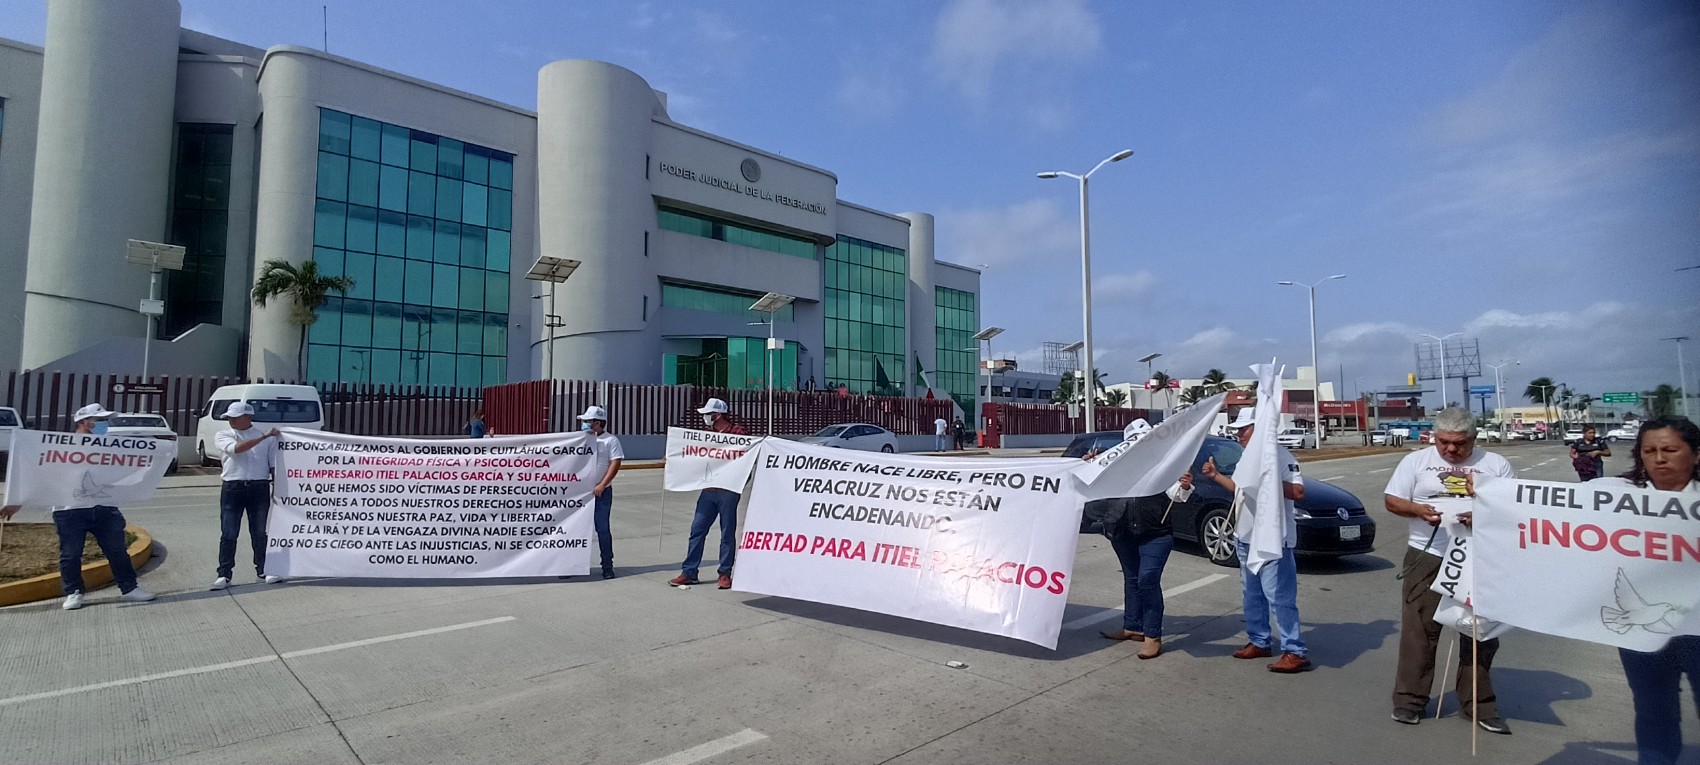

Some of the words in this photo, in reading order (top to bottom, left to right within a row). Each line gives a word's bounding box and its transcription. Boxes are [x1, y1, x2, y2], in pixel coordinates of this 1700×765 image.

[660, 162, 696, 182] PODER
[699, 172, 743, 194] JUDICIAL
[745, 185, 759, 198] DE
[761, 189, 773, 201] LA
[776, 194, 827, 215] FEDERACIÓN
[42, 433, 76, 445] ITIEL
[81, 436, 157, 450] PALACIOS
[683, 431, 703, 442] ITIEL
[705, 433, 752, 446] PALACIOS
[278, 441, 394, 454] RESPONSABILIZAMOS
[397, 445, 411, 454] AL
[414, 446, 472, 455] GOBIERNO
[474, 446, 487, 455] DE
[490, 444, 550, 455] CUITLÁHUC
[553, 444, 594, 456] GARCÍA
[39, 450, 154, 467] ¡INOCENTE!
[318, 455, 339, 465] POR
[342, 456, 356, 465] LA
[358, 456, 424, 466] INTEGRIDAD
[426, 457, 461, 467] FÍSICA
[464, 459, 472, 467] Y
[474, 456, 550, 468] PSICOLÓGICA
[287, 469, 304, 478] DEL
[307, 469, 374, 479] EMPRESARIO
[376, 470, 400, 480] ITIEL
[403, 471, 458, 480] PALACIOS
[461, 469, 504, 481] GARCÍA
[507, 472, 514, 481] Y
[517, 473, 531, 482] SU
[535, 473, 581, 482] FAMILIA.
[765, 454, 780, 469] EL
[783, 455, 852, 472] HOMBRE
[853, 462, 905, 477] NACE
[905, 468, 962, 485] LIBRE,
[968, 472, 1026, 490] PERO
[1030, 475, 1061, 494] EN
[298, 483, 312, 492] YA
[314, 483, 335, 494] QUE
[338, 484, 376, 493] HEMOS
[379, 484, 405, 493] SIDO
[408, 482, 460, 495] VÍCTIMAS
[463, 486, 477, 495] DE
[480, 484, 557, 495] PERSECUCIÓN
[560, 486, 568, 495] Y
[794, 477, 884, 499] VERACRUZ
[886, 484, 928, 503] NOS
[932, 489, 1001, 512] ESTÁN
[280, 497, 348, 507] VIOLACIONES
[350, 498, 358, 507] A
[361, 498, 398, 507] TODOS
[401, 498, 460, 508] NUESTROS
[462, 499, 522, 509] DERECHOS
[525, 499, 586, 509] HUMANOS.
[1516, 484, 1583, 510] ITIEL
[306, 509, 374, 521] REGRÉSANOS
[377, 512, 426, 522] NUESTRA
[429, 513, 457, 524] PAZ,
[460, 513, 487, 522] VIDA
[491, 513, 499, 522] Y
[501, 513, 556, 522] LIBERTAD.
[292, 524, 306, 534] DE
[307, 525, 320, 534] LA
[323, 523, 339, 535] IRÁ
[341, 525, 349, 534] Y
[351, 526, 364, 535] DE
[367, 526, 380, 535] LA
[383, 526, 438, 536] VENGAZA
[441, 527, 480, 536] DIVINA
[483, 527, 517, 536] NADIE
[520, 526, 567, 536] ESCAPA.
[270, 538, 294, 548] DIOS
[296, 539, 312, 548] NO
[315, 539, 328, 548] ES
[330, 540, 363, 549] CIEGO
[365, 540, 393, 550] ANTE
[396, 541, 417, 550] LAS
[420, 541, 491, 552] INJUSTICIAS,
[494, 541, 506, 550] NI
[509, 541, 523, 549] SE
[525, 539, 588, 549] CORROMPE
[739, 531, 808, 554] IBERTAD
[810, 536, 866, 561] PARA
[871, 543, 922, 570] ITIEL
[369, 555, 405, 564] COMO
[407, 555, 419, 564] EL
[422, 555, 478, 565] HUMANO.
[1440, 536, 1467, 598] ACIOS
